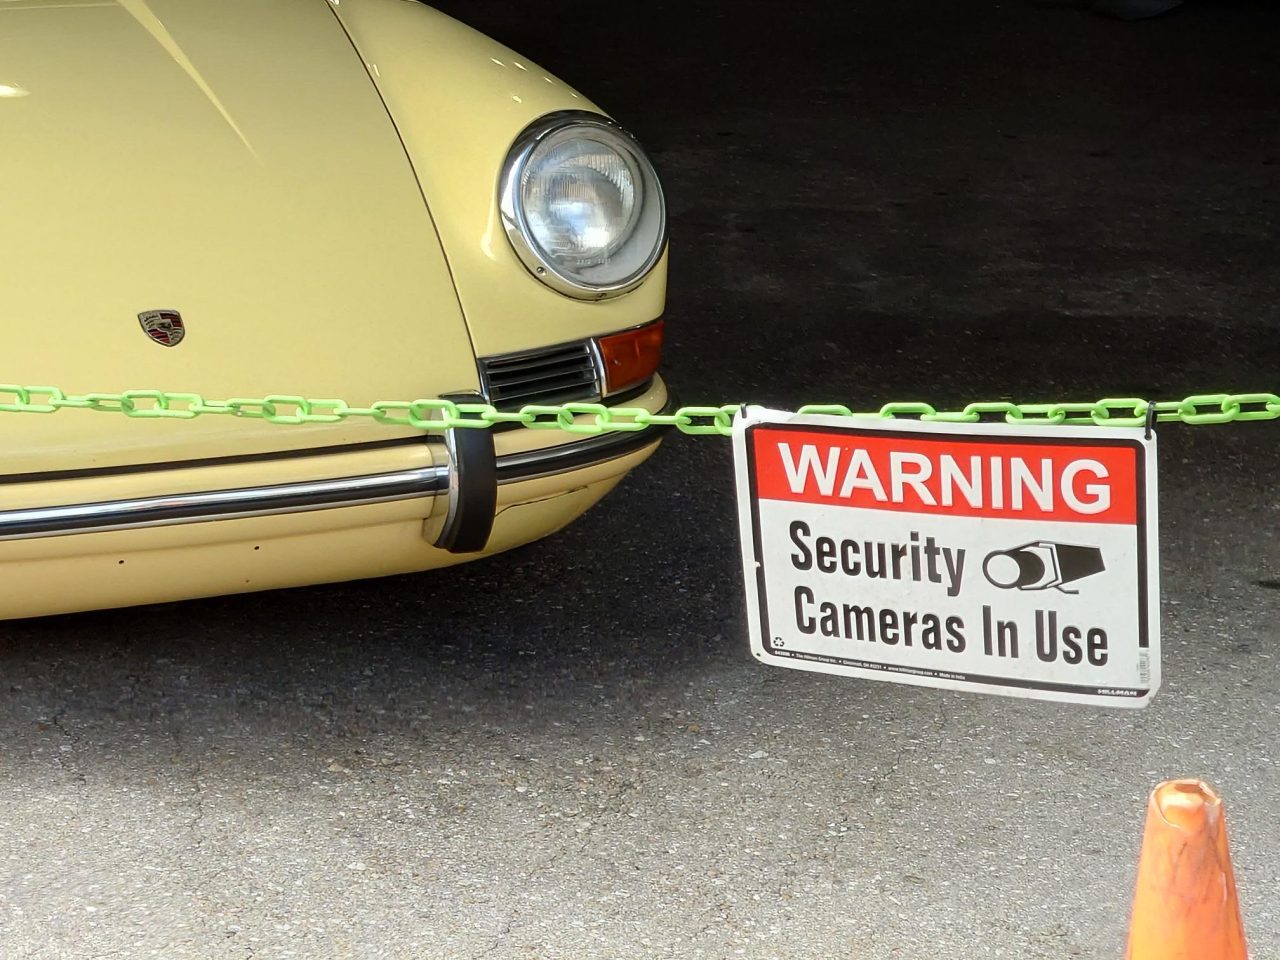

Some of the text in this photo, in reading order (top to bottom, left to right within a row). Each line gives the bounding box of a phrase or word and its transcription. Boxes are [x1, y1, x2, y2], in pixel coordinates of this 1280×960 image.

[778, 442, 1111, 515] WARNING
[789, 520, 966, 597] Security
[794, 585, 1109, 667] Cameras In Use
